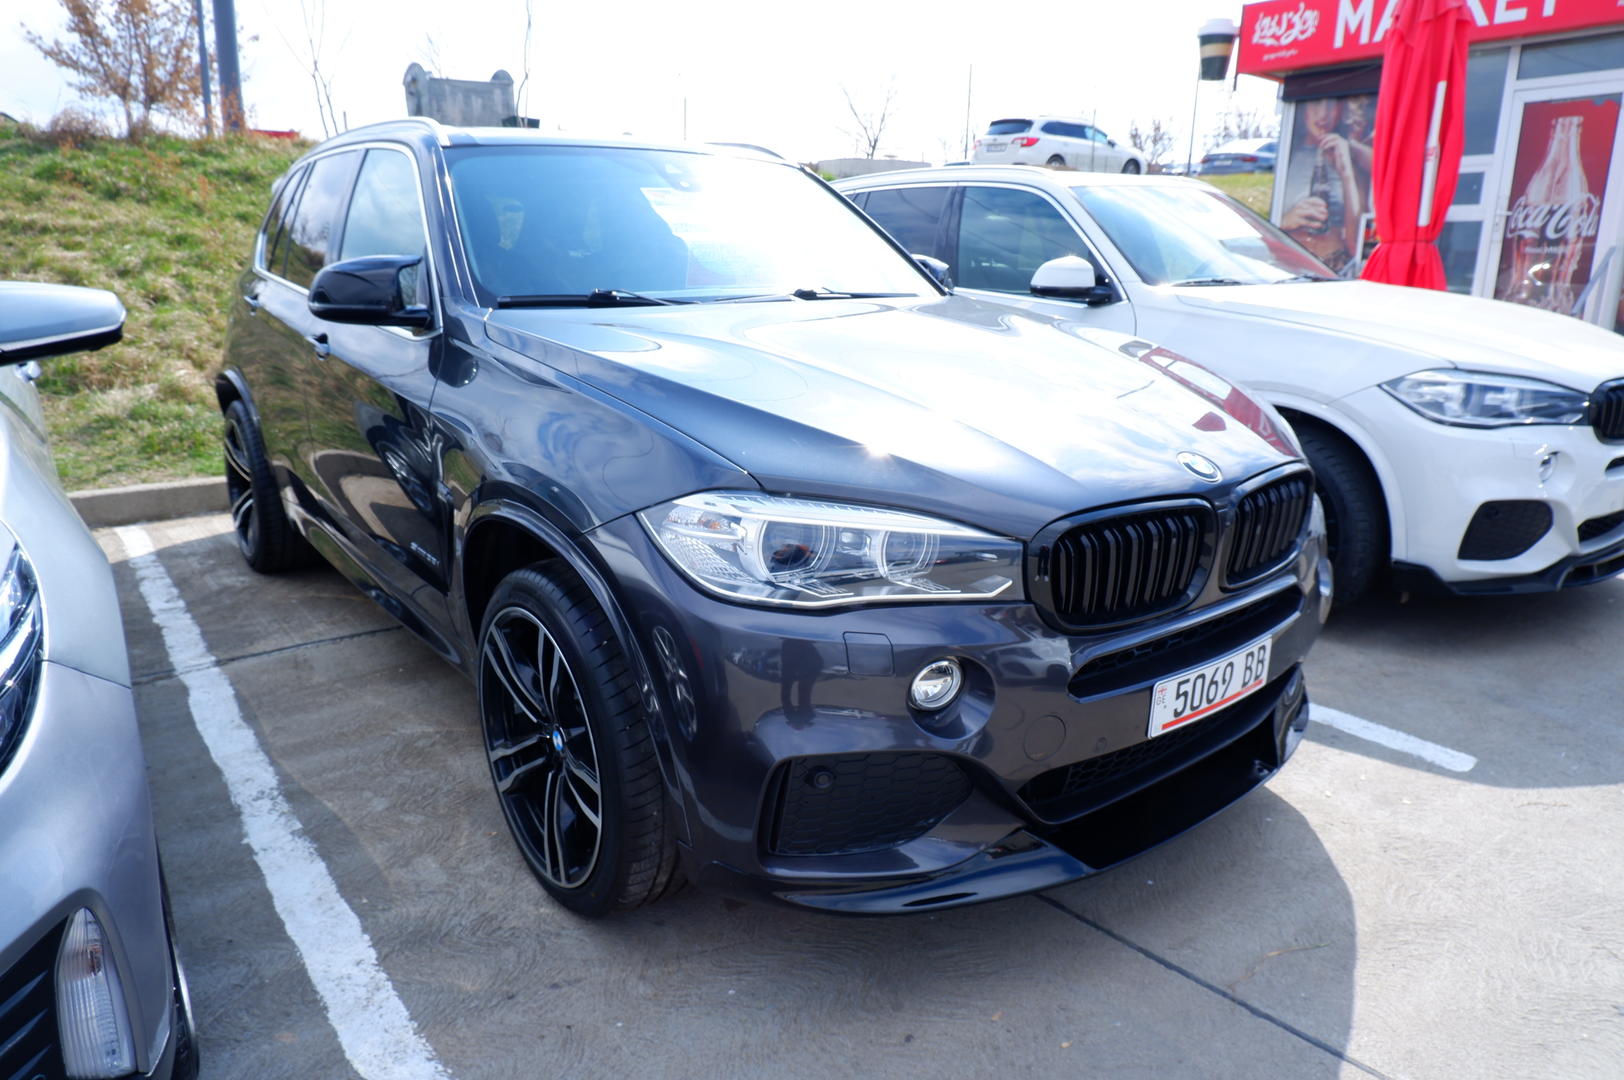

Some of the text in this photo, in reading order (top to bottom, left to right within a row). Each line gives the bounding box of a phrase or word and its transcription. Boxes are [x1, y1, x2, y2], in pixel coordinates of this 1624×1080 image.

[1333, 0, 1557, 49] MAE
[1173, 644, 1267, 718] 5069 BB
